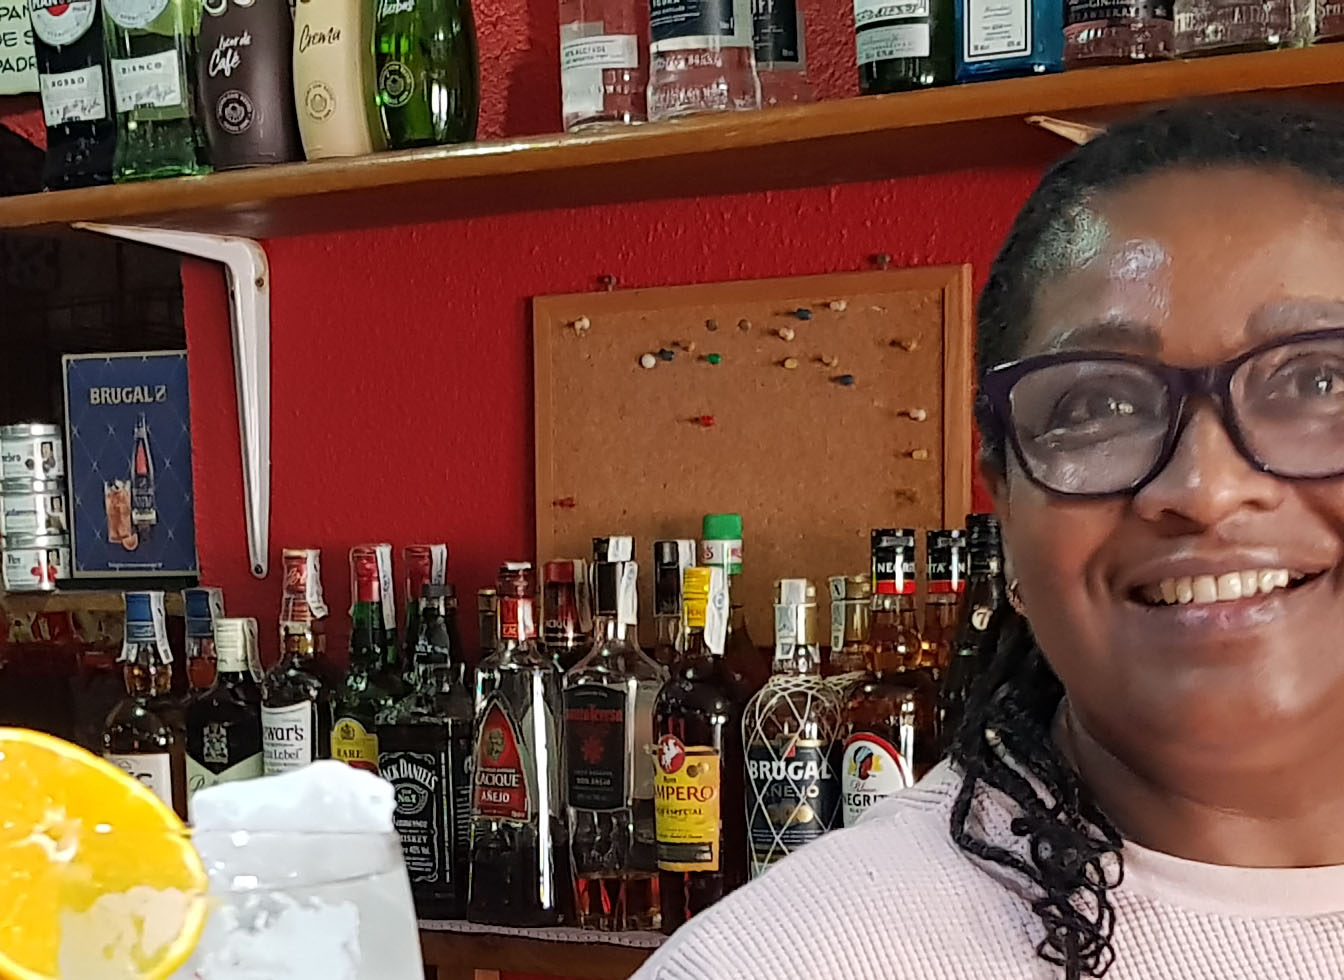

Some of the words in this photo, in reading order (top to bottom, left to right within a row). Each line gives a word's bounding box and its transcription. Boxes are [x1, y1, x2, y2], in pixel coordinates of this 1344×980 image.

[208, 49, 241, 77] Café
[90, 386, 154, 405] BRUGAL
[474, 772, 521, 788] CACIQUE
[749, 759, 833, 782] BRUGAL
[480, 789, 511, 804] AÑEJO
[656, 784, 715, 803] MPERO
